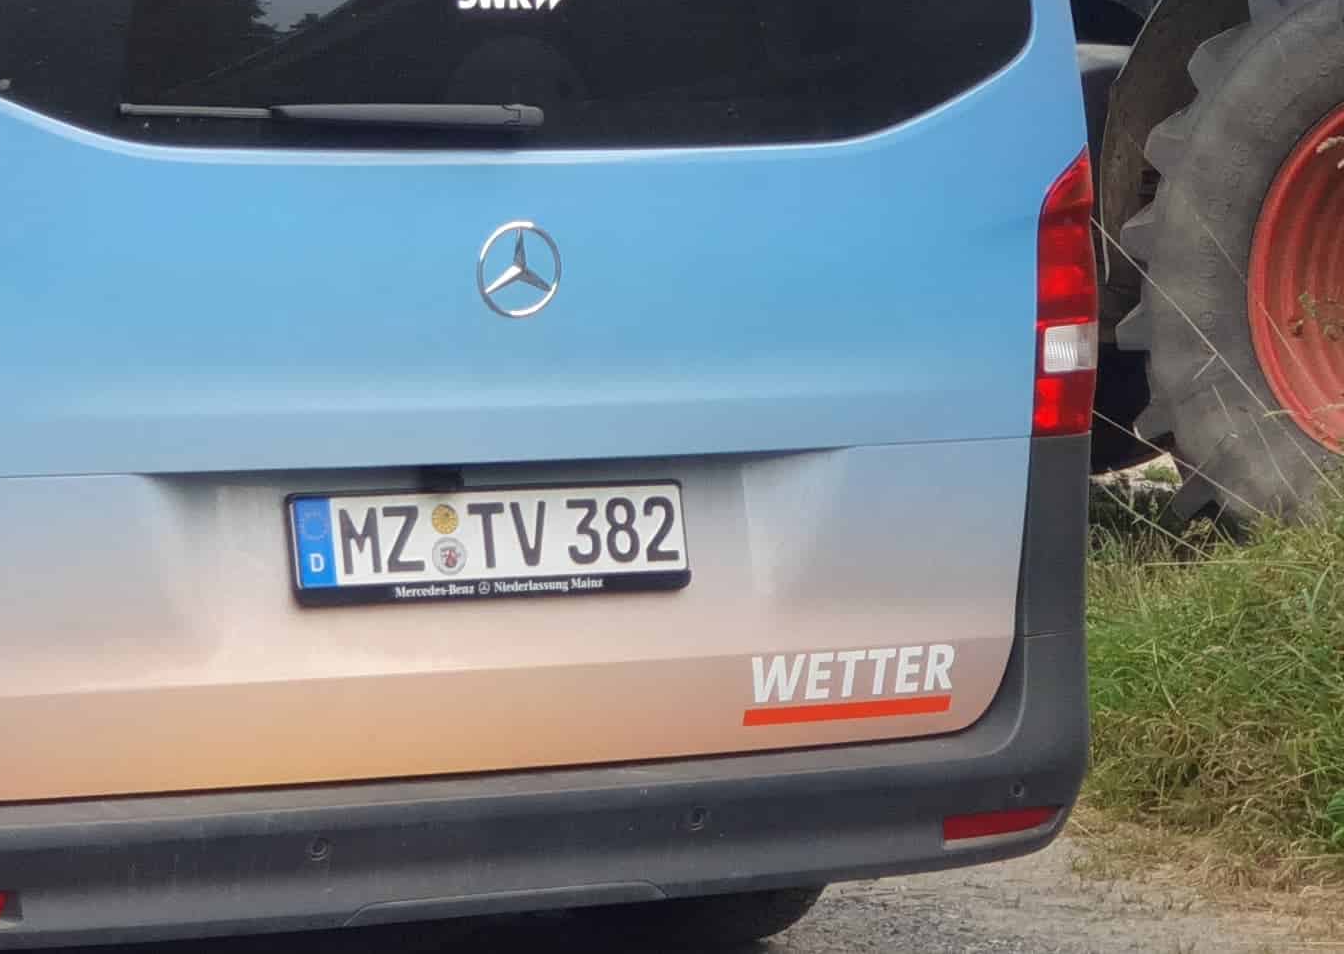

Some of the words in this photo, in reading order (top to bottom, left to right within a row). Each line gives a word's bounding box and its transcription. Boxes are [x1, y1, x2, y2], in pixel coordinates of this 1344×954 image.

[338, 505, 425, 575] MZ
[467, 501, 546, 568] TV
[565, 496, 680, 565] 382
[309, 554, 324, 572] D
[395, 584, 475, 598] Mercedes-Benz
[494, 580, 569, 593] Niederlassung
[571, 578, 604, 590] Mainz
[751, 644, 955, 703] WETTER
